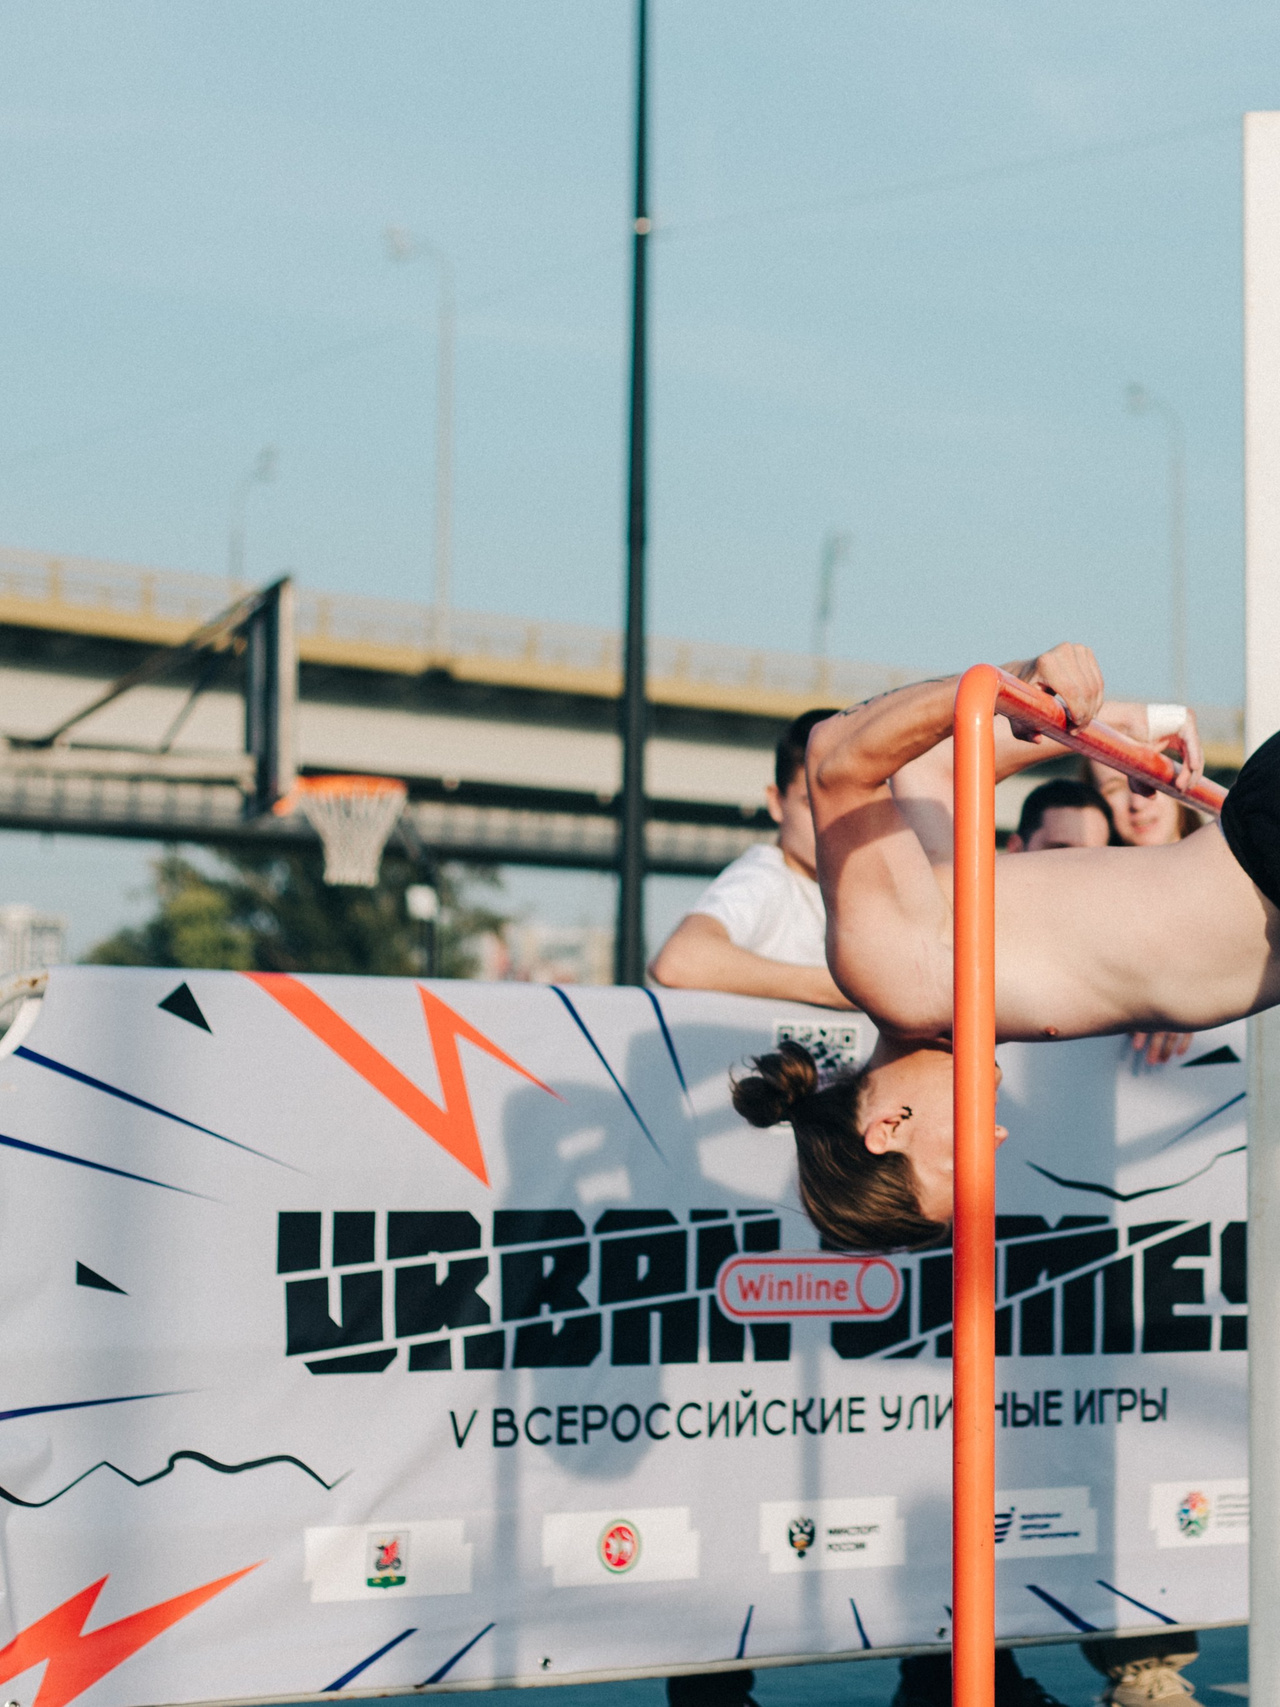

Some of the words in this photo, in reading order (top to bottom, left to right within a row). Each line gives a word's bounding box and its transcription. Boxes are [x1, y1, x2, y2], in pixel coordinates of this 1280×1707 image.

[276, 1208, 791, 1375] URBAN
[736, 1272, 850, 1303] Winline
[449, 1409, 478, 1448] V
[492, 1389, 867, 1447] ВСЕРОССИЙСКИЕ
[880, 1388, 1063, 1432] УЛИНЫЕ
[1073, 1386, 1168, 1426] ИГРЫ
